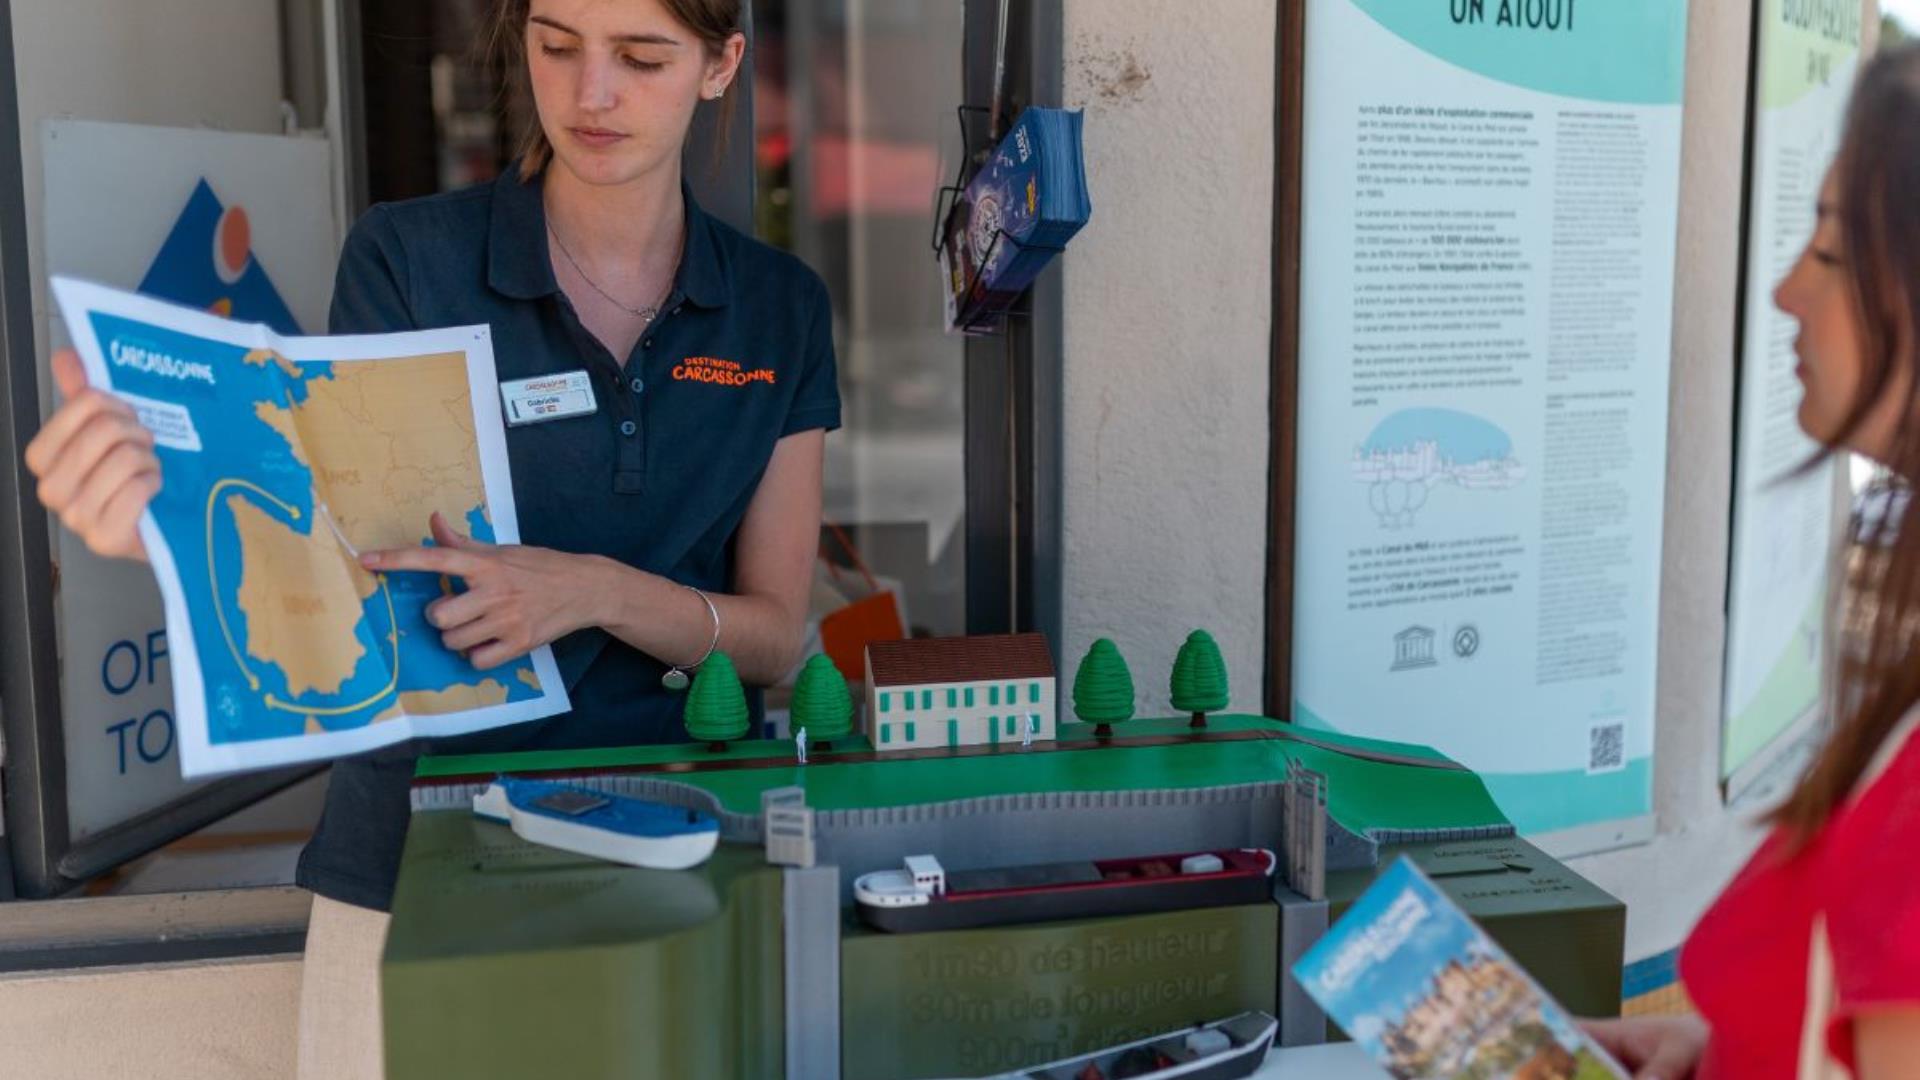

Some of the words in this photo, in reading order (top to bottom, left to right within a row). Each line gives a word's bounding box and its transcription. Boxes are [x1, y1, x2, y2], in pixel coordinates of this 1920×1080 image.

[110, 339, 216, 386] CARCASSONNE
[672, 364, 775, 386] CARCASSONNE
[684, 356, 741, 370] DESTINATION
[1031, 942, 1075, 973] de
[1090, 931, 1224, 972] hauteur
[1009, 990, 1052, 1020] de
[1058, 974, 1226, 1017] longueur
